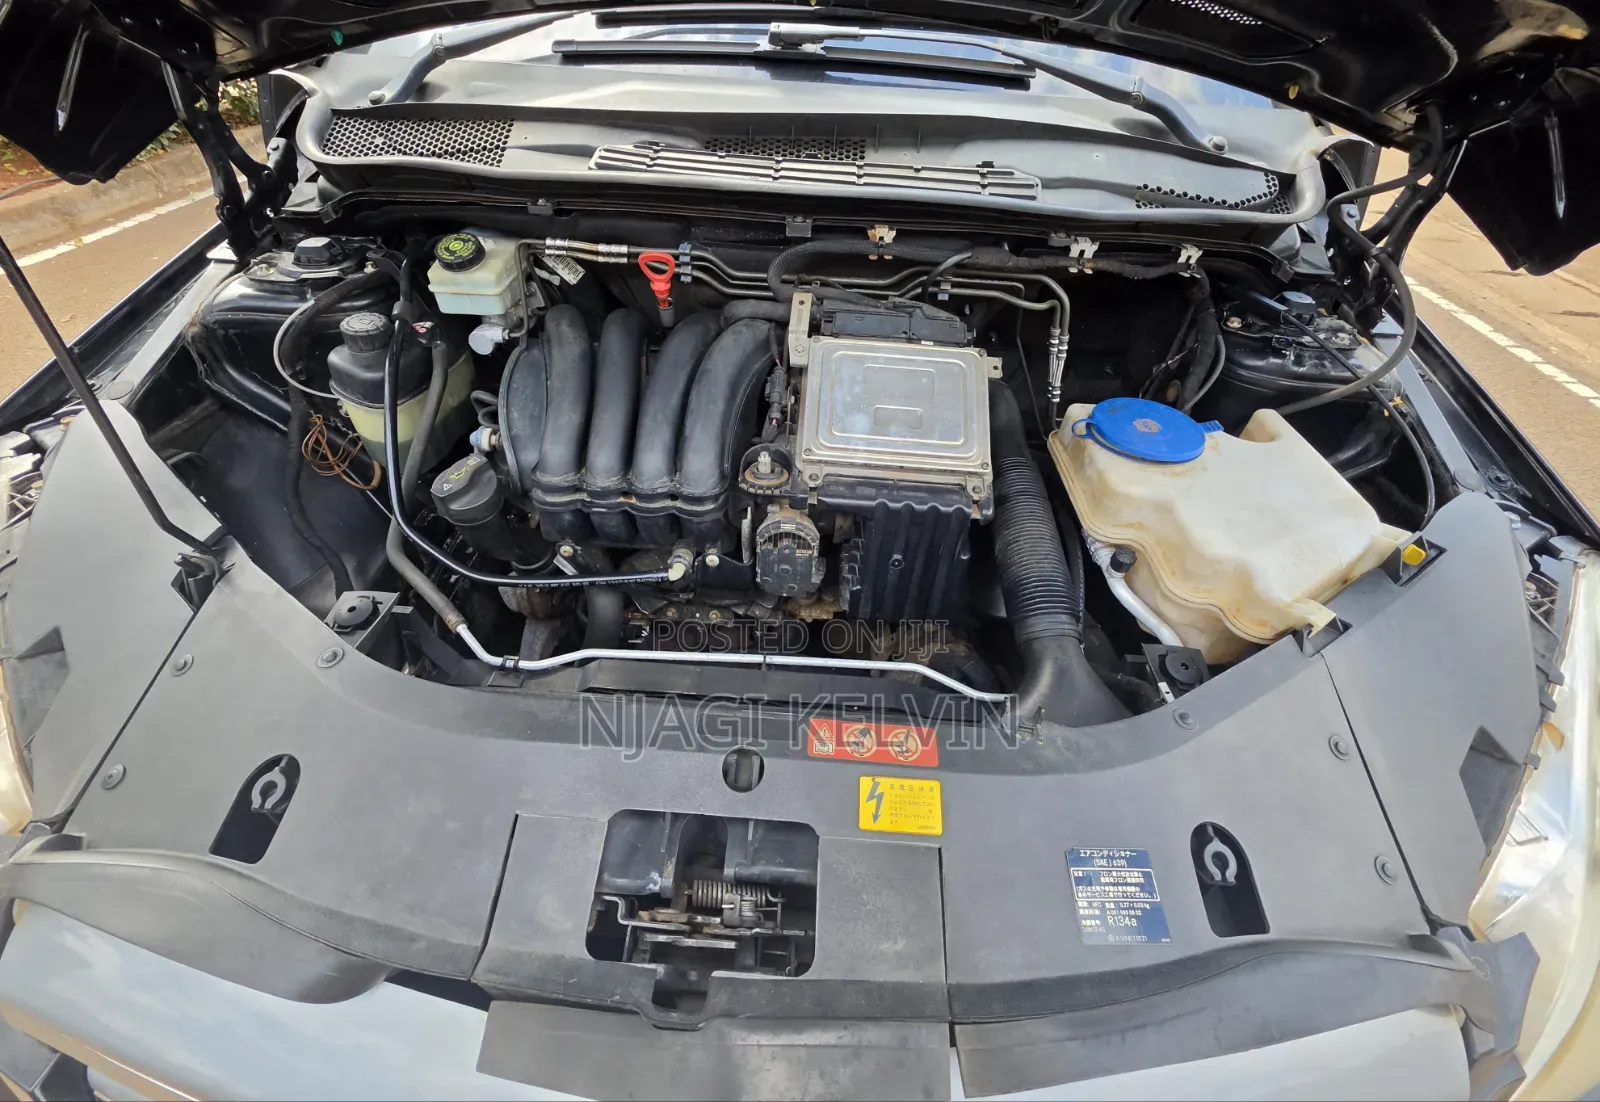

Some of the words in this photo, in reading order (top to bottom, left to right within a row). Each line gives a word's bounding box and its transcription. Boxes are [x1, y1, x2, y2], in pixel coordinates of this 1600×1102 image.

[1079, 849, 1137, 858] エアコンディショナー
[1107, 915, 1138, 927] R134a
